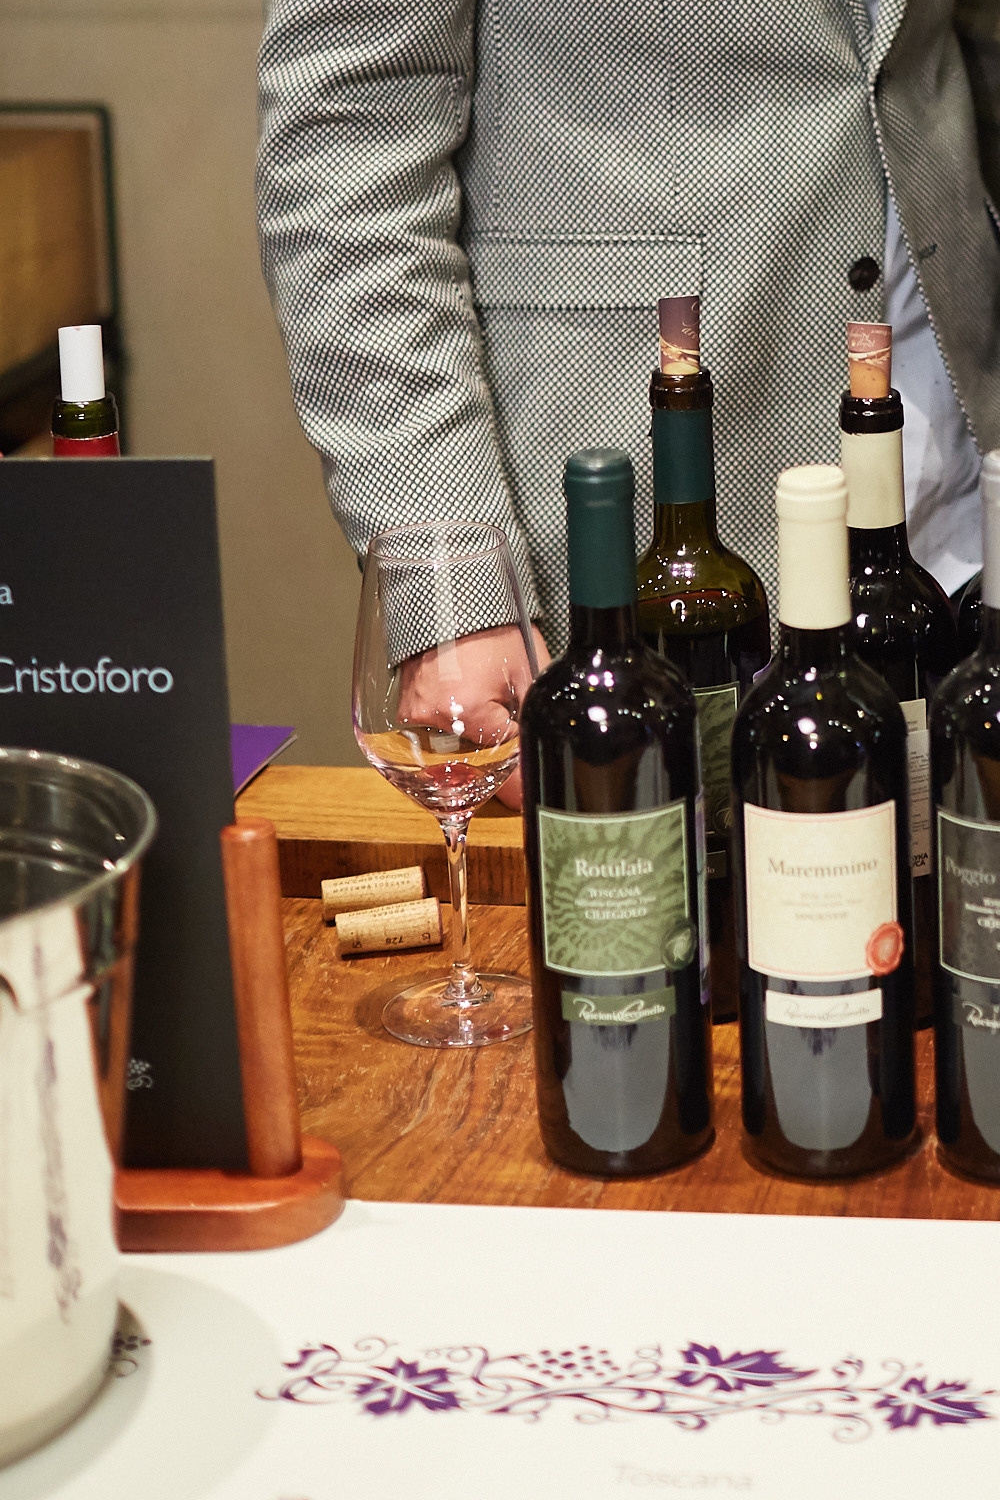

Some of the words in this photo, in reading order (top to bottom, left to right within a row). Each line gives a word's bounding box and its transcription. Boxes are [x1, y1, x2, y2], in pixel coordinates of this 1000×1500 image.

[575, 857, 654, 878] Rotulaia
[767, 857, 878, 879] Maremmino
[945, 854, 996, 887] Poggio
